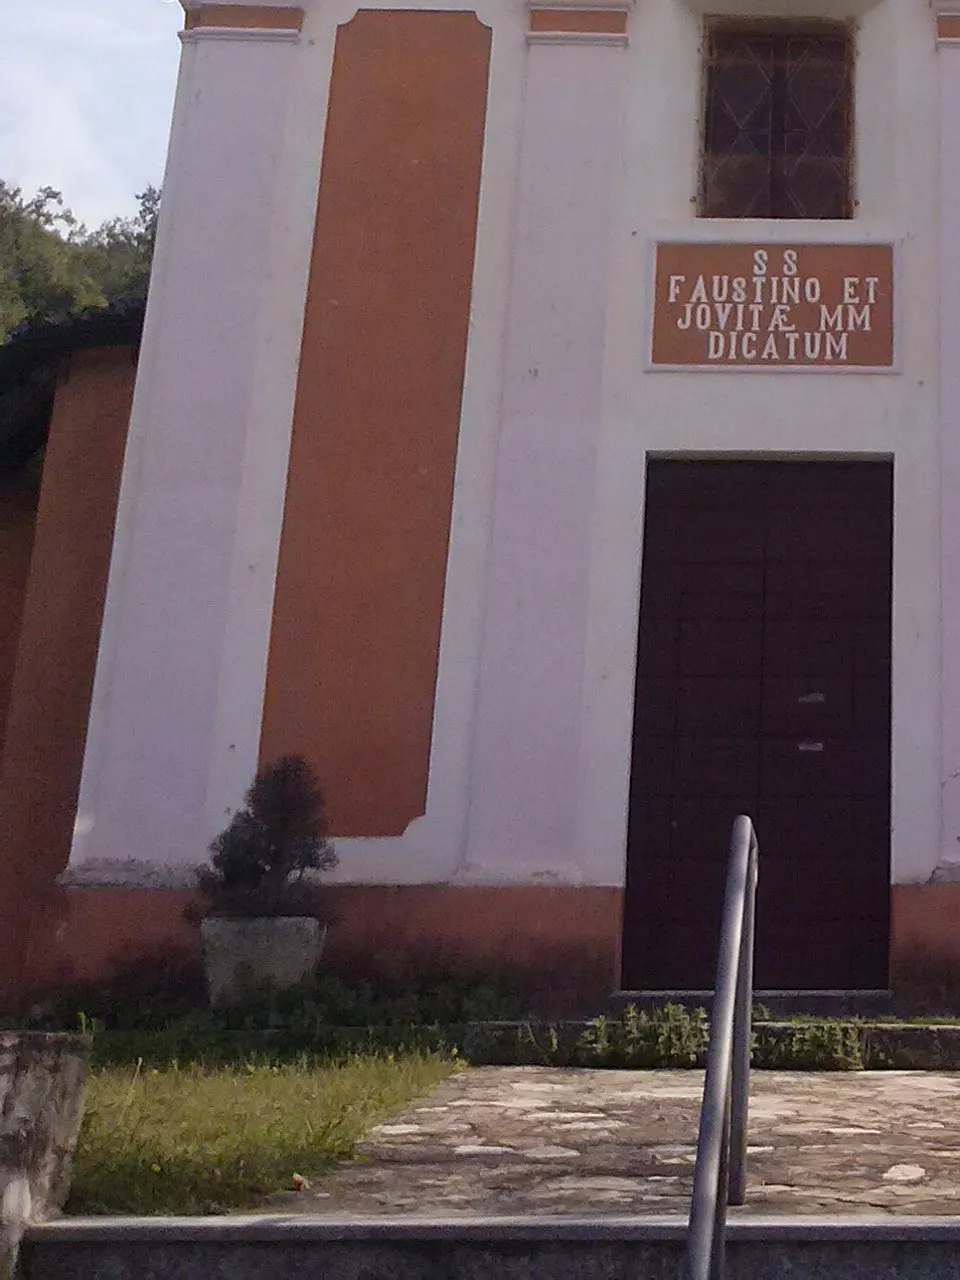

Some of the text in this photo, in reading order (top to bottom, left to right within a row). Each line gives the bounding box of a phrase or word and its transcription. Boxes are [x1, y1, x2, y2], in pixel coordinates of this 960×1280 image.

[668, 275, 879, 303] FAUSTINO ET
[819, 305, 871, 331] MM
[708, 332, 848, 359] DICATUM
